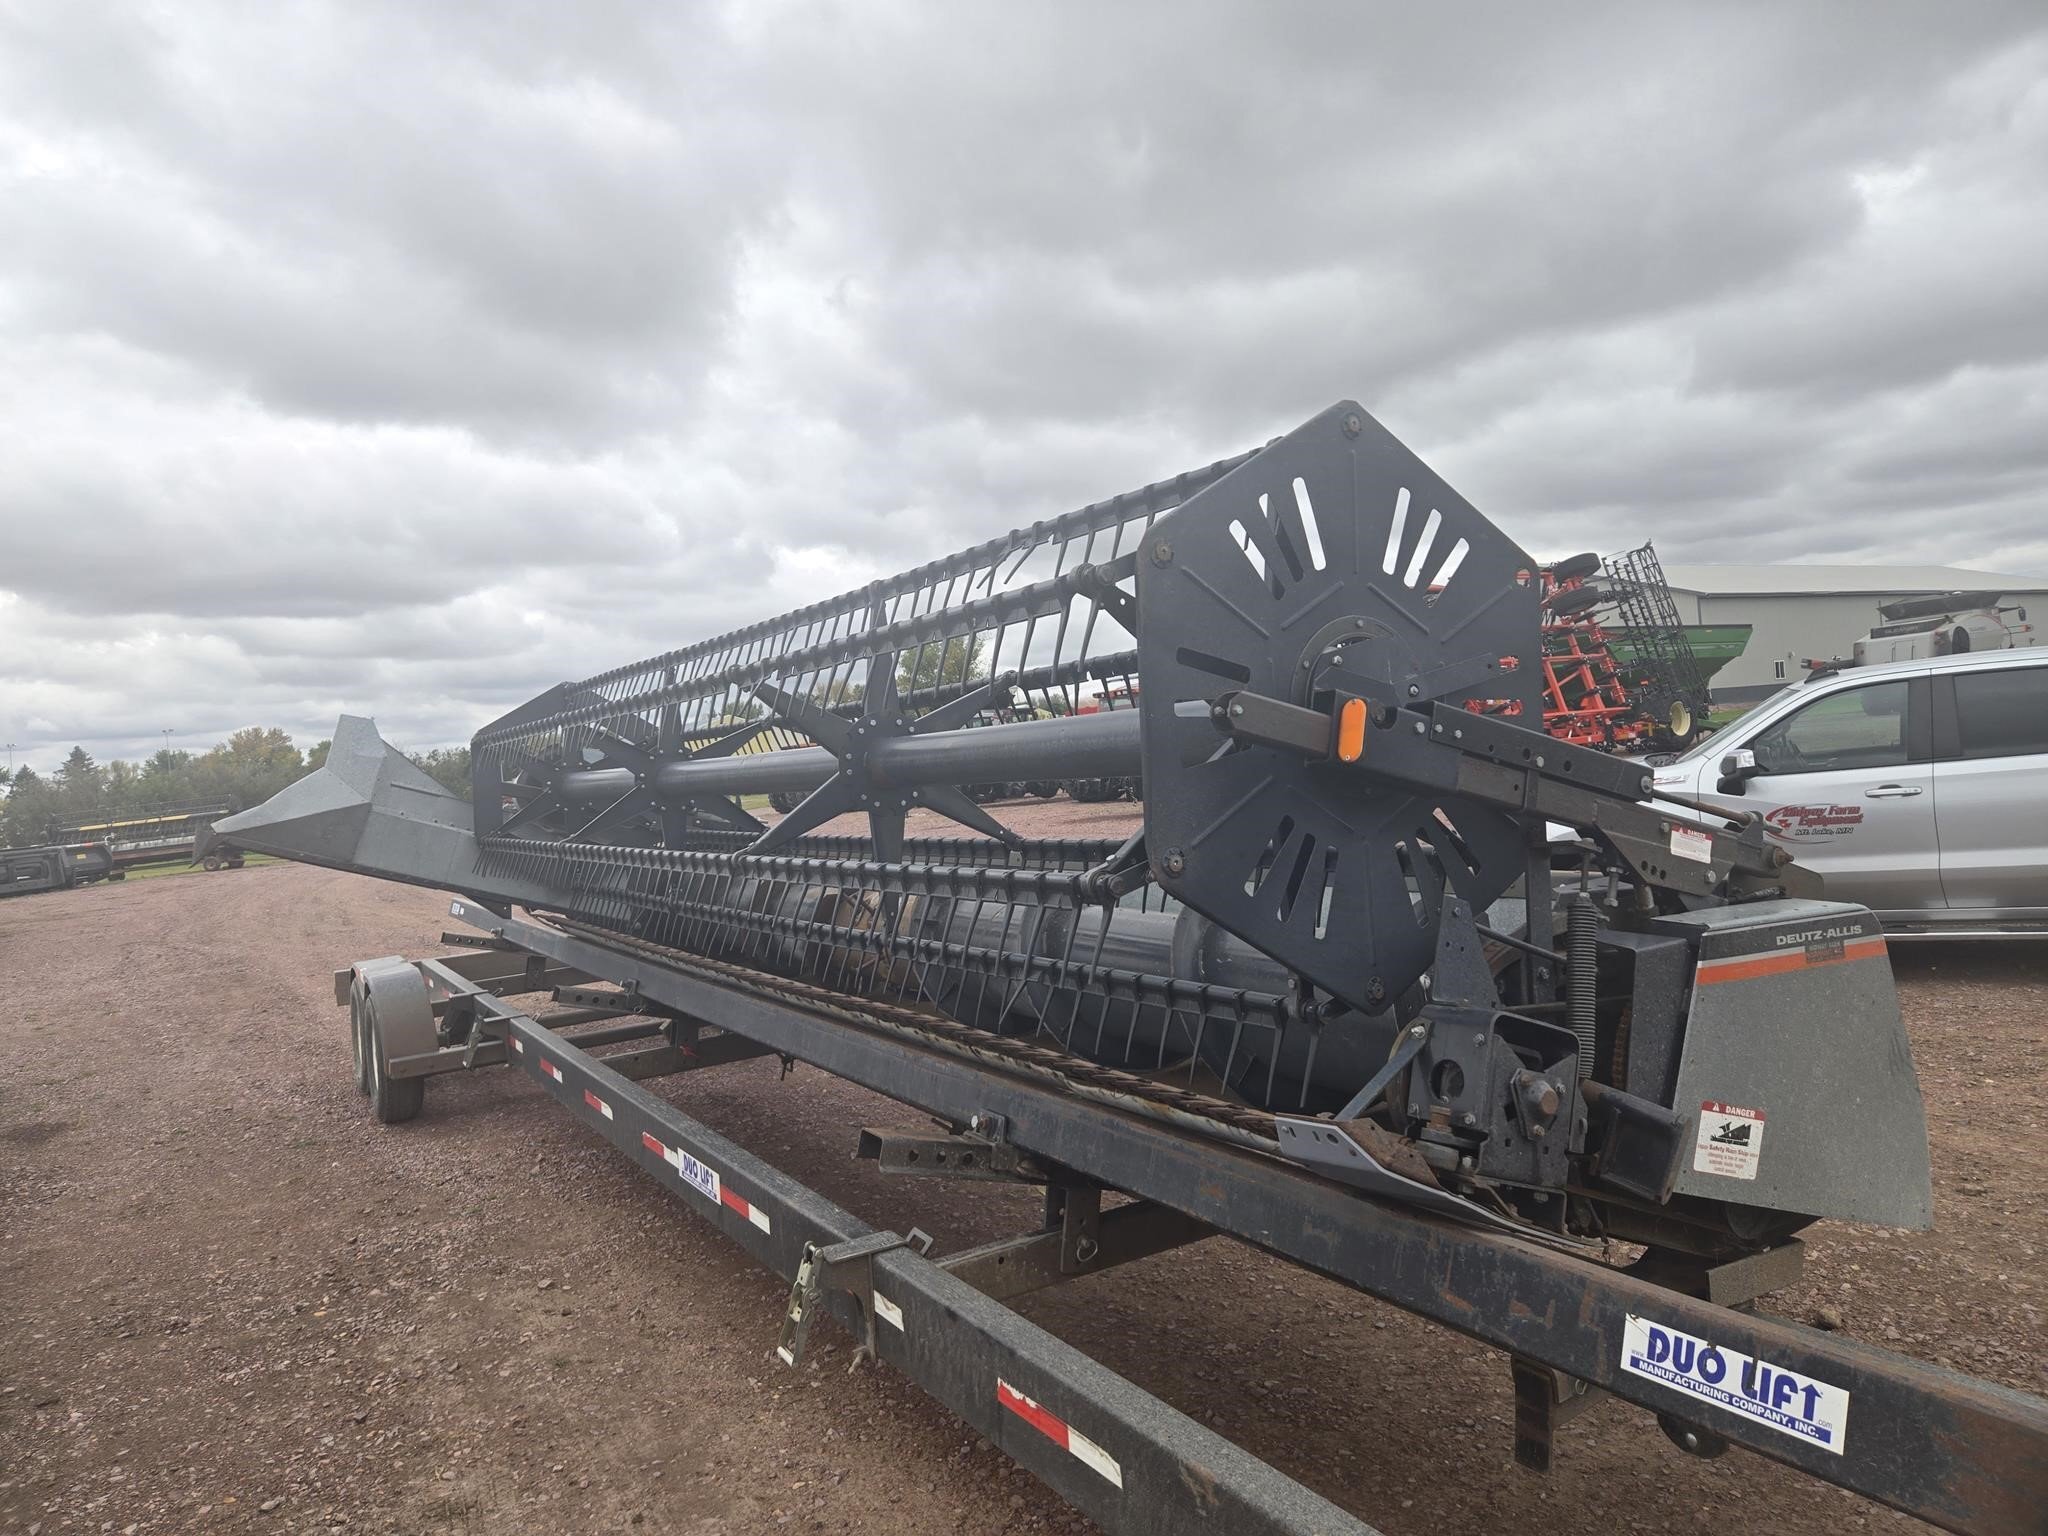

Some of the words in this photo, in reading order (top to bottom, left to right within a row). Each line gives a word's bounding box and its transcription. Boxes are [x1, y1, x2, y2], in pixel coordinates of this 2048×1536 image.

[1798, 813, 1864, 827] Equipment
[1828, 805, 1861, 816] Farm
[1725, 1105, 1756, 1118] DANGER
[683, 1153, 699, 1179] DUO
[700, 1163, 714, 1191] LIFT
[1646, 1326, 1727, 1385] DUO
[1740, 1360, 1823, 1422] LIFT
[1639, 1359, 1730, 1403] MANUFACTURING
[1732, 1396, 1792, 1429] COMPANY,
[1794, 1421, 1820, 1438] INC.
